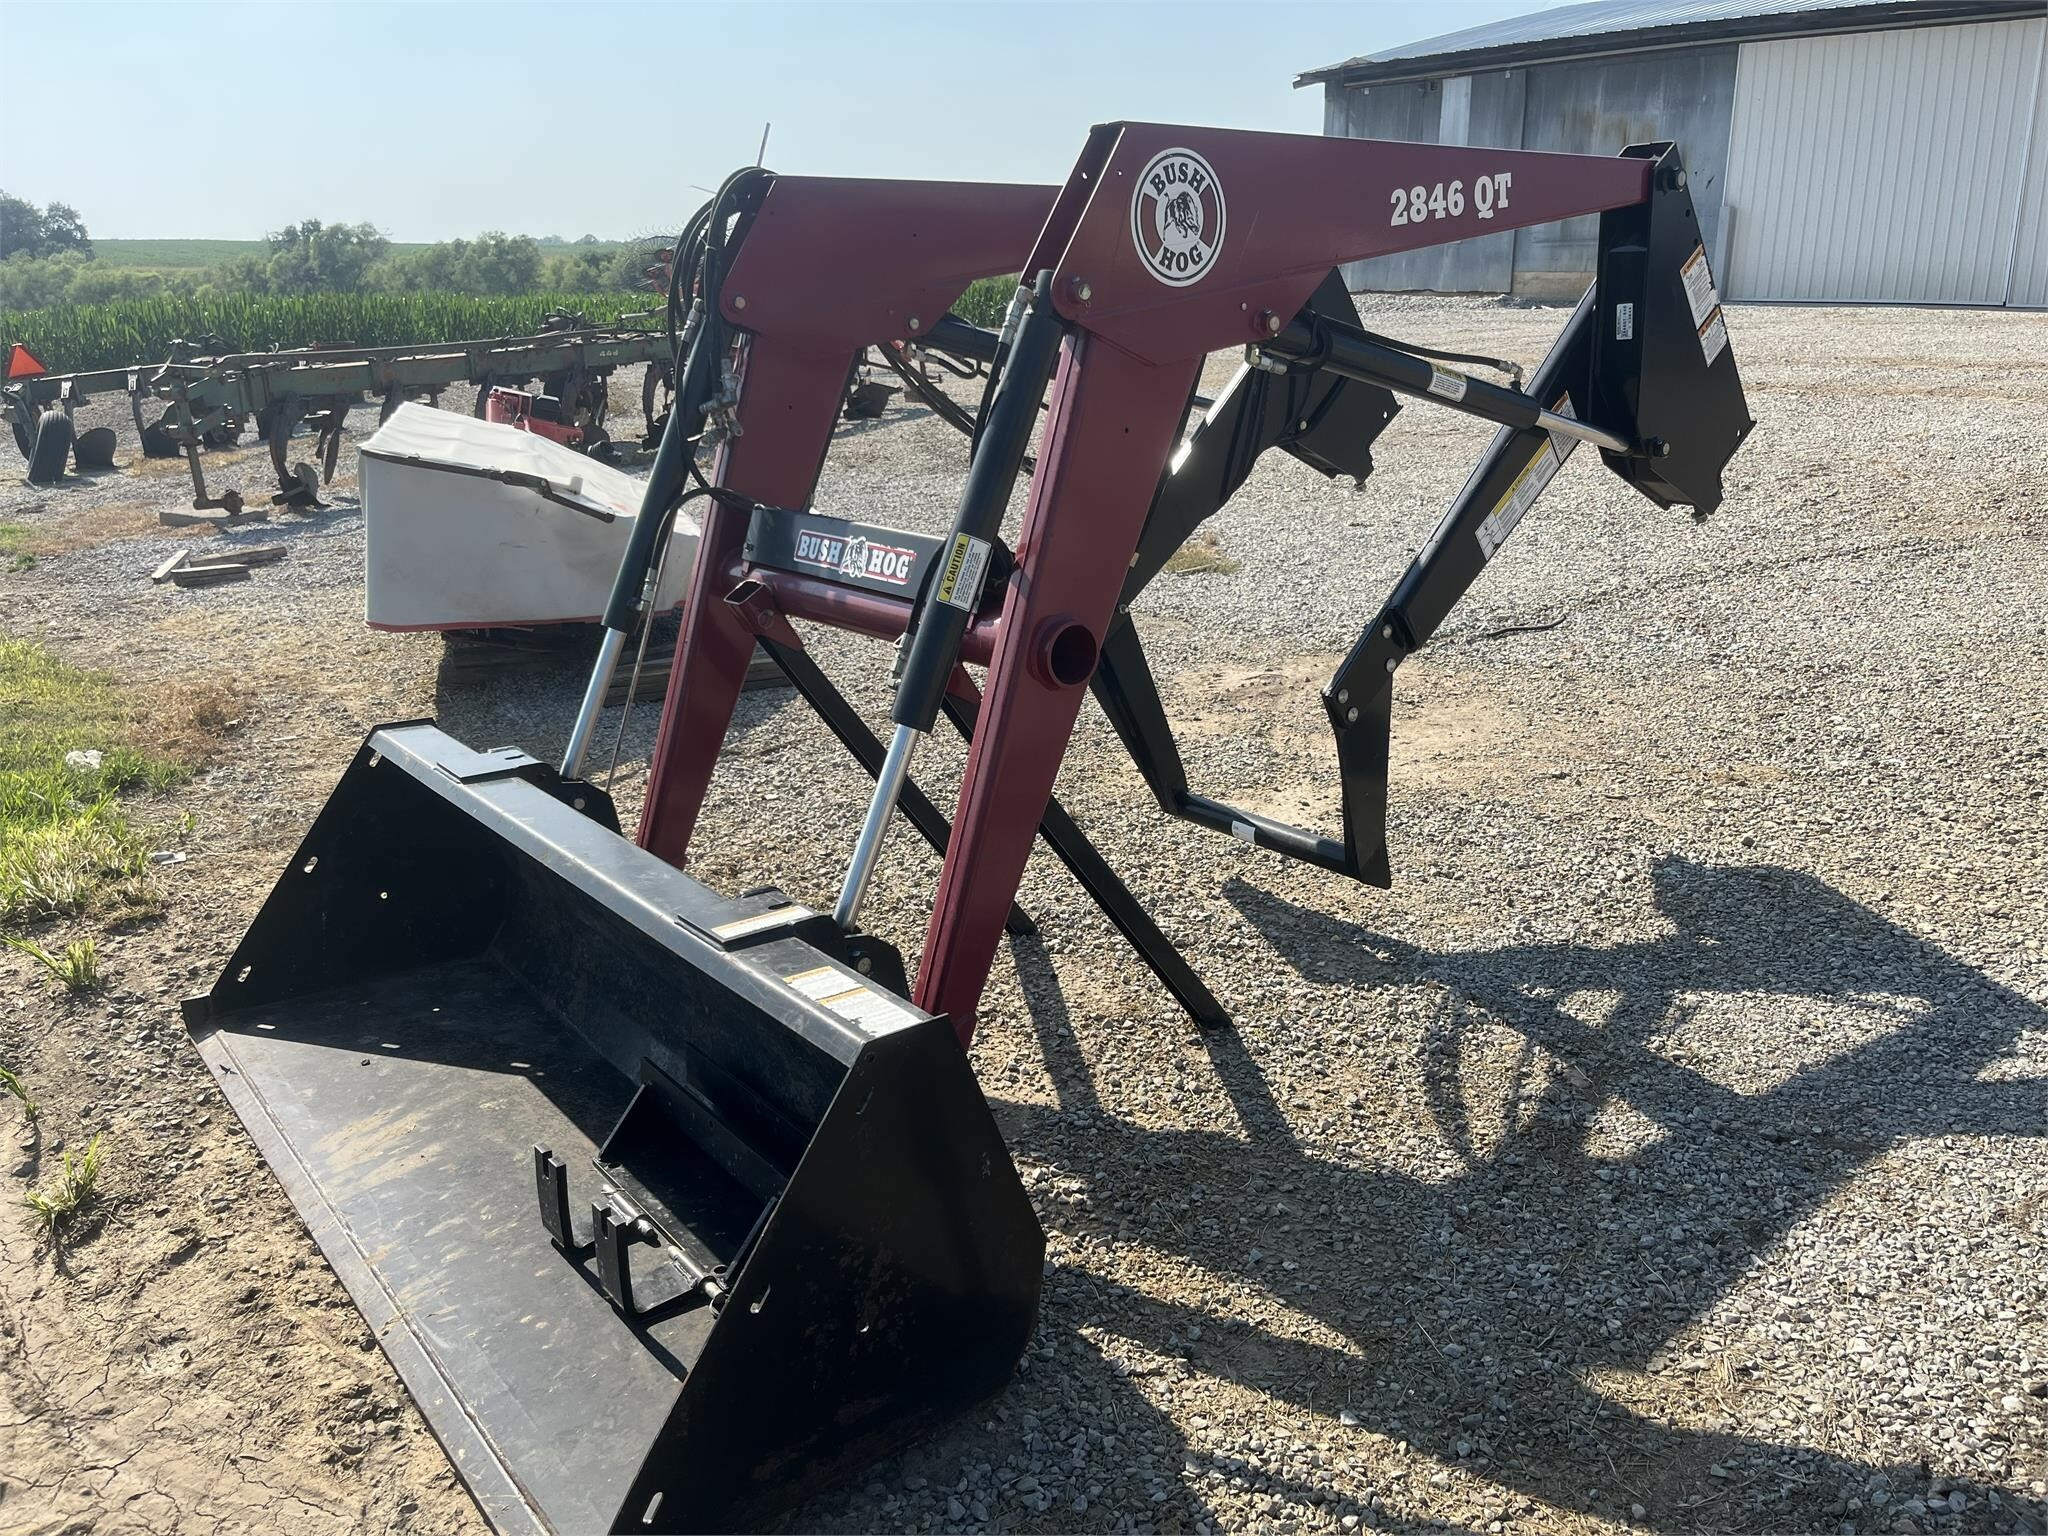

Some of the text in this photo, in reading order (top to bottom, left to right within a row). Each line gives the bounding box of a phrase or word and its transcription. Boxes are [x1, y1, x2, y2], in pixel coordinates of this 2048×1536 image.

[1150, 162, 1206, 196] BUSH
[1390, 172, 1511, 226] 2846 QT
[1159, 244, 1203, 272] HOG
[797, 535, 910, 579] BUSH HOG
[946, 542, 966, 582] CAUTION
